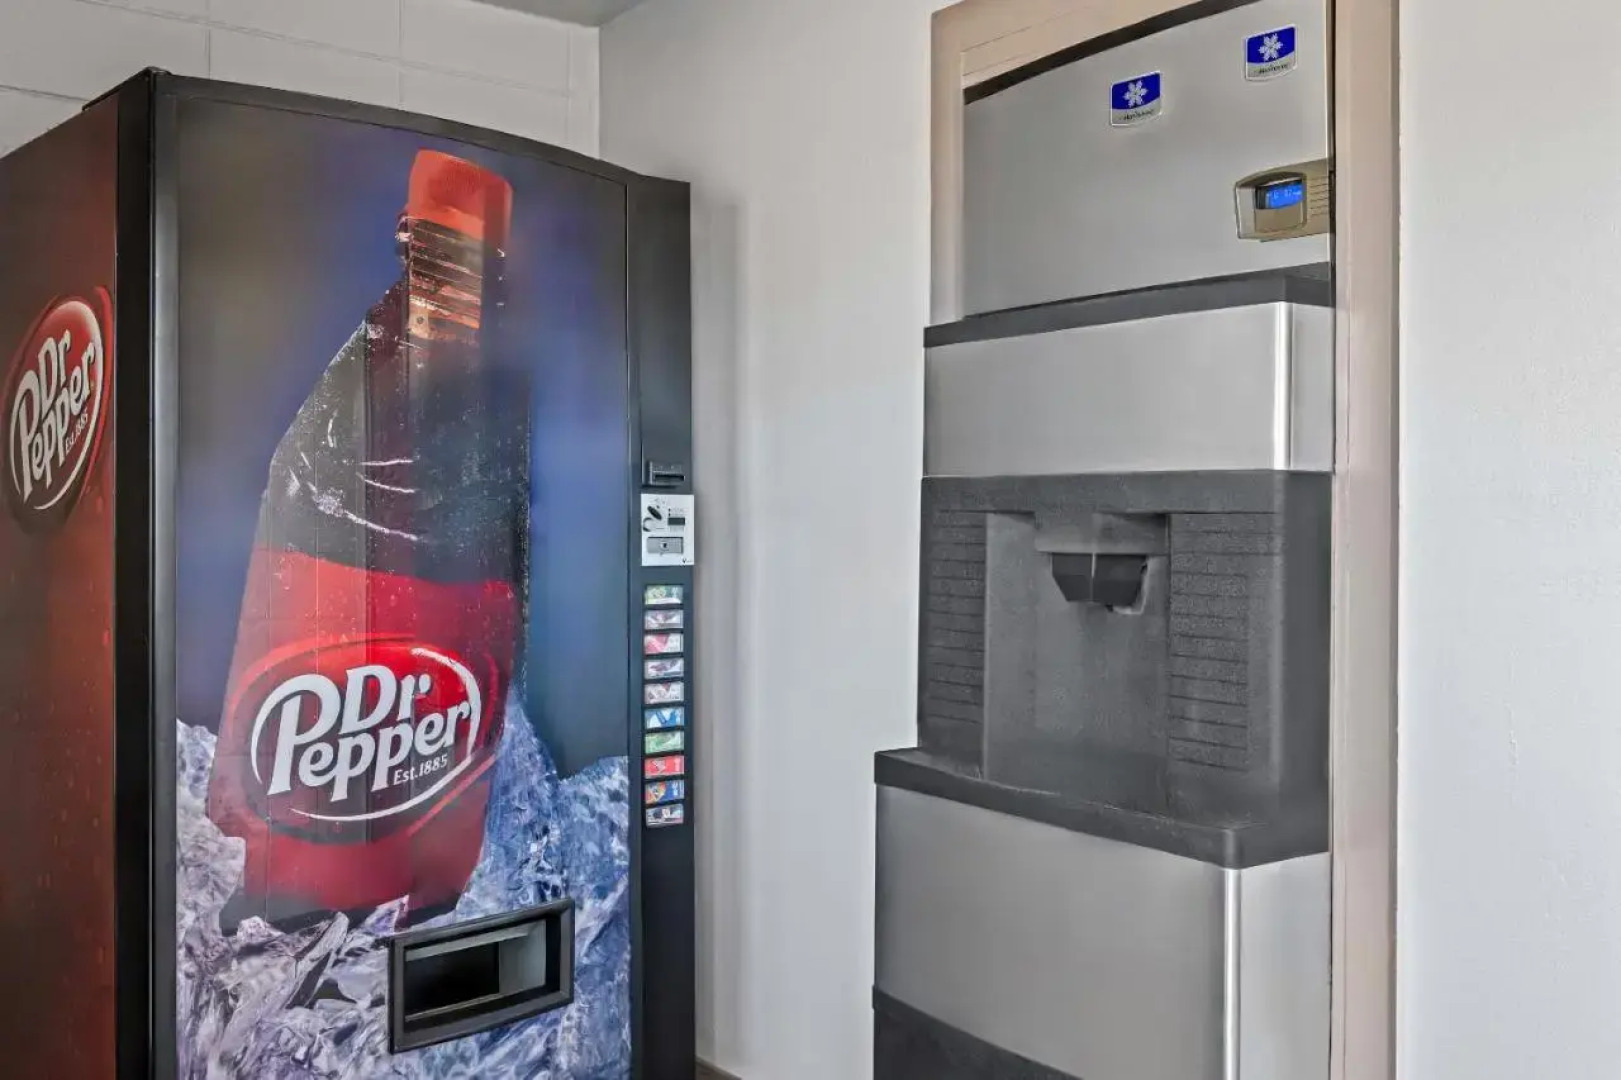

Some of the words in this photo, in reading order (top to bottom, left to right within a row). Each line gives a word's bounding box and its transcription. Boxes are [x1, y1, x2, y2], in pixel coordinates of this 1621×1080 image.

[38, 330, 71, 415] Dr
[10, 342, 95, 503] Pepper
[251, 674, 471, 802] Pepper
[338, 665, 431, 734] Dr
[393, 753, 449, 786] Est.1885
